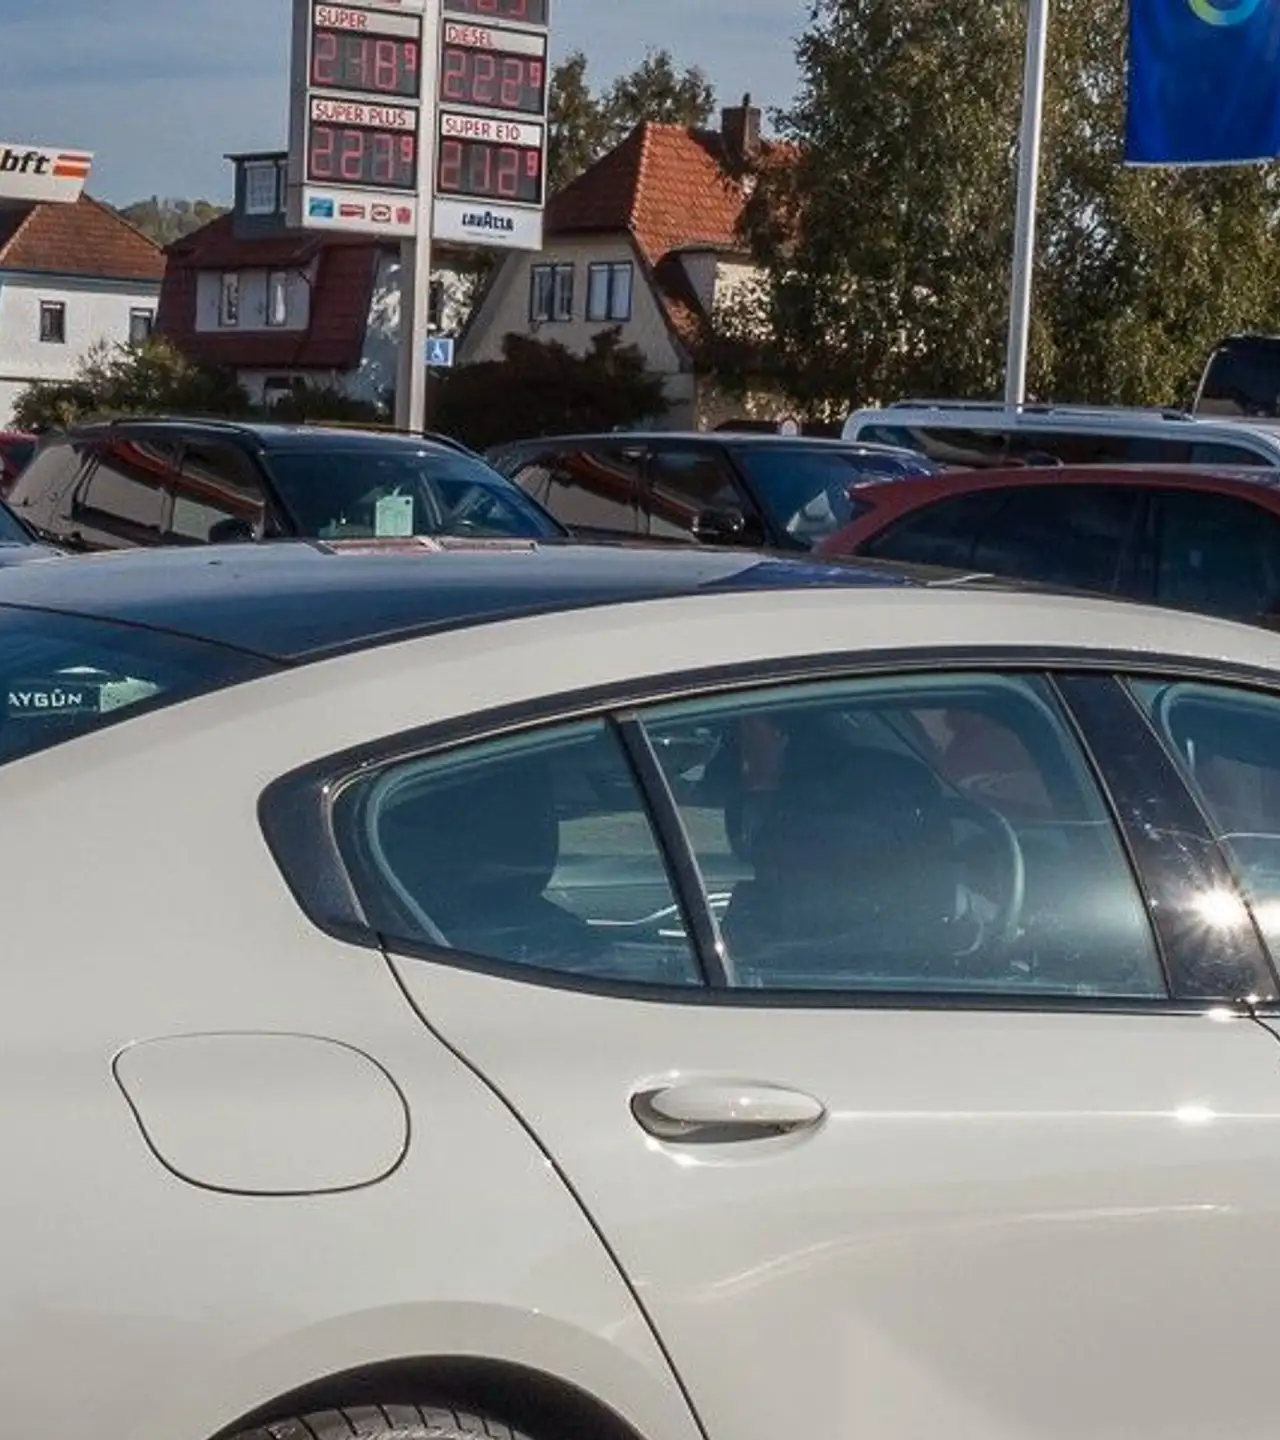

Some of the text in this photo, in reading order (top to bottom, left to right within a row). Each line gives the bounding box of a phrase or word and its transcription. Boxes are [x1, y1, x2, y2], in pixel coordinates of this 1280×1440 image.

[318, 7, 368, 27] SUPER
[447, 26, 493, 46] DIESEL
[316, 102, 407, 126] SUPER PLUS
[445, 117, 520, 140] SUPER E10
[0, 149, 51, 174] bft
[8, 688, 82, 708] AYGÜN
